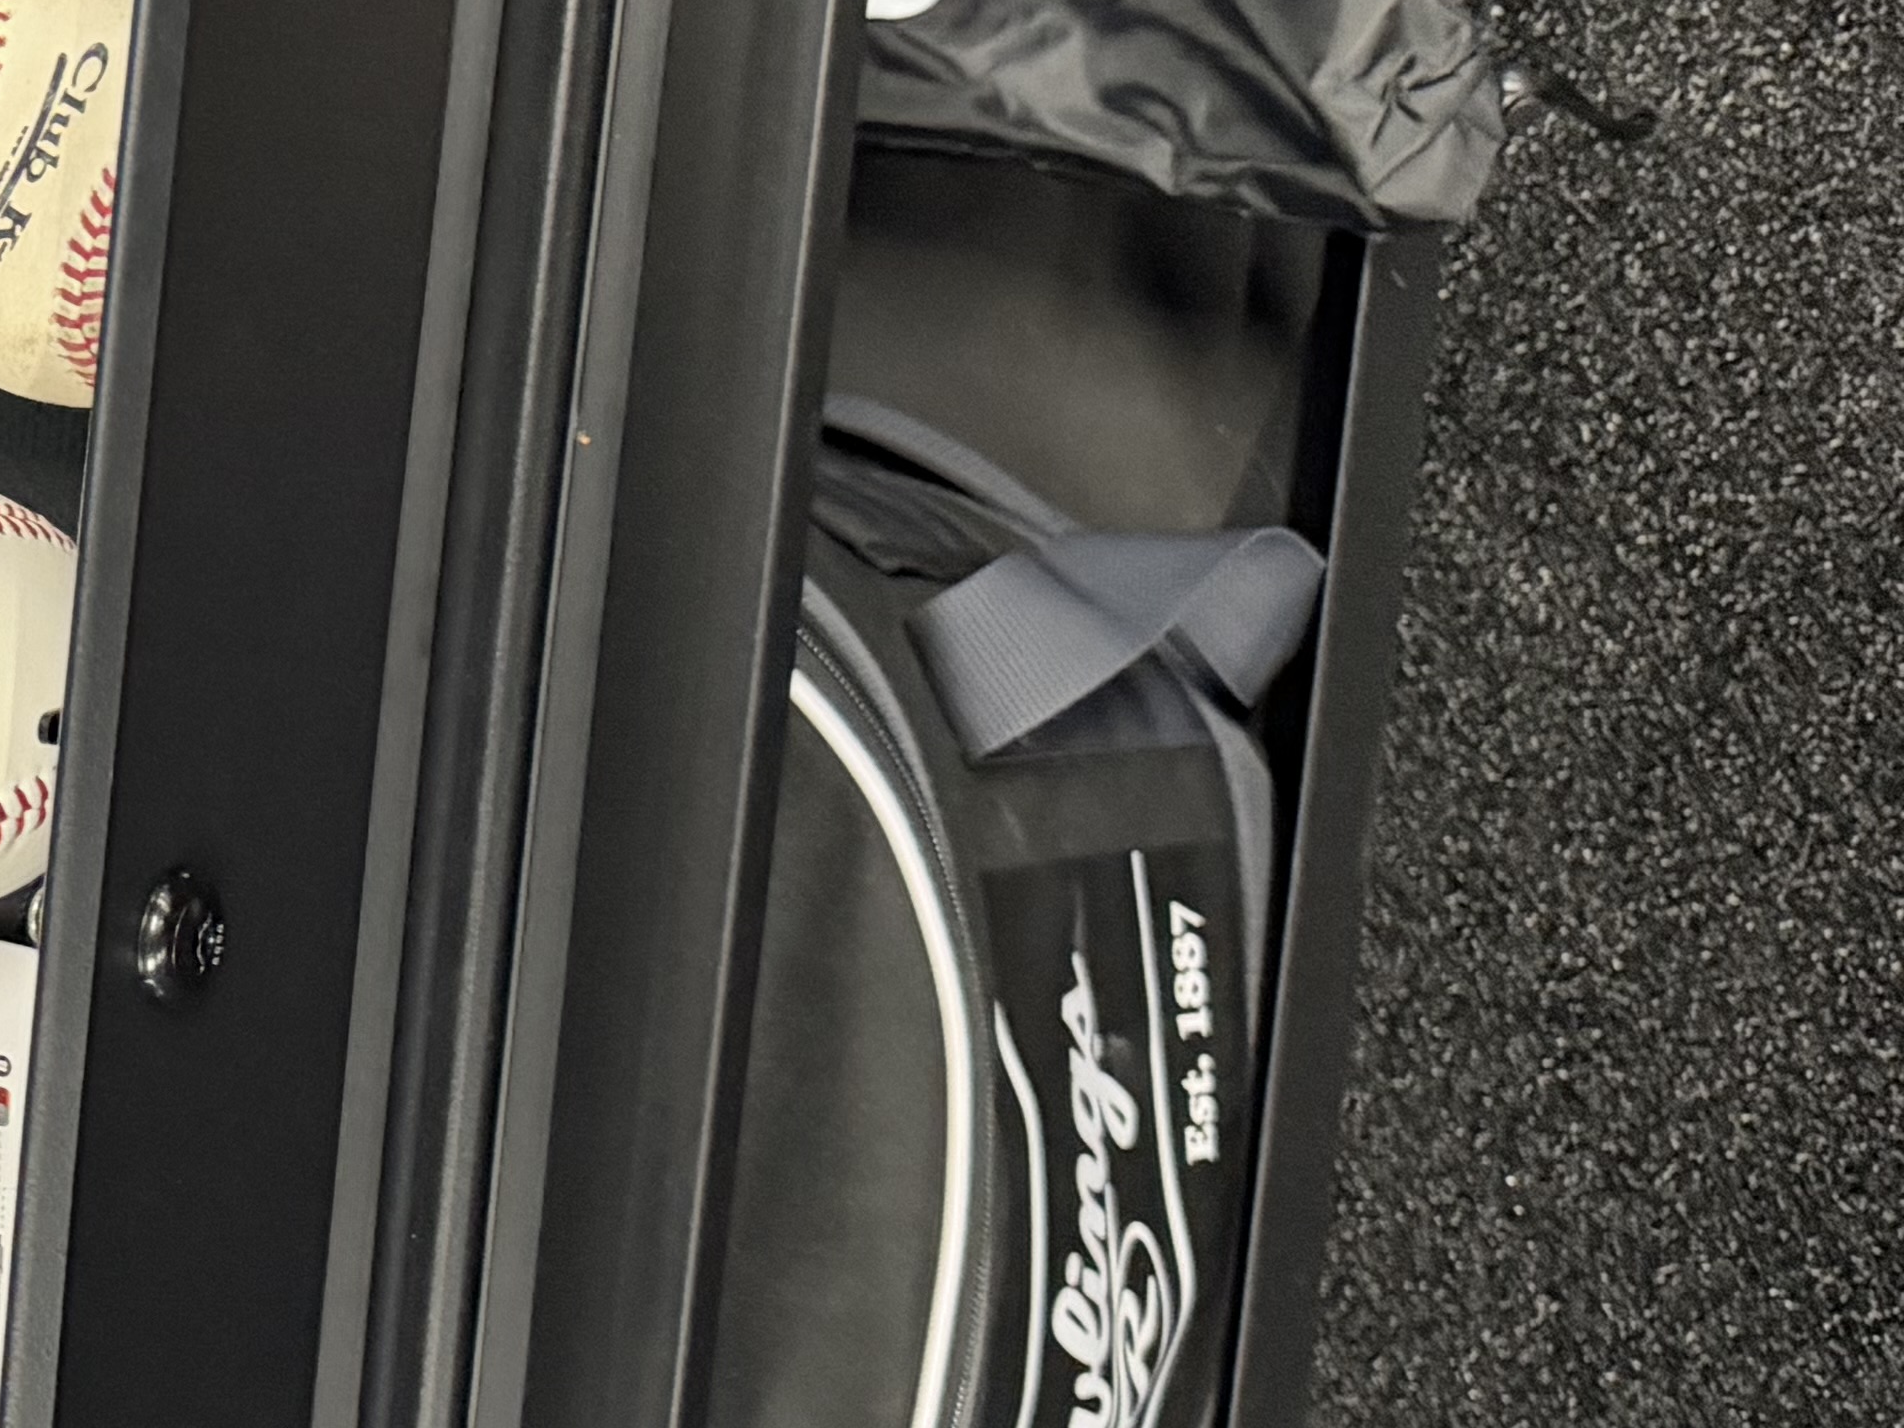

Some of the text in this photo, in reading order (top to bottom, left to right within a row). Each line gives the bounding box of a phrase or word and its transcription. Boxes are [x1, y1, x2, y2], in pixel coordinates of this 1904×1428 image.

[26, 42, 109, 183] Club
[1168, 900, 1220, 1167] Est. 1887
